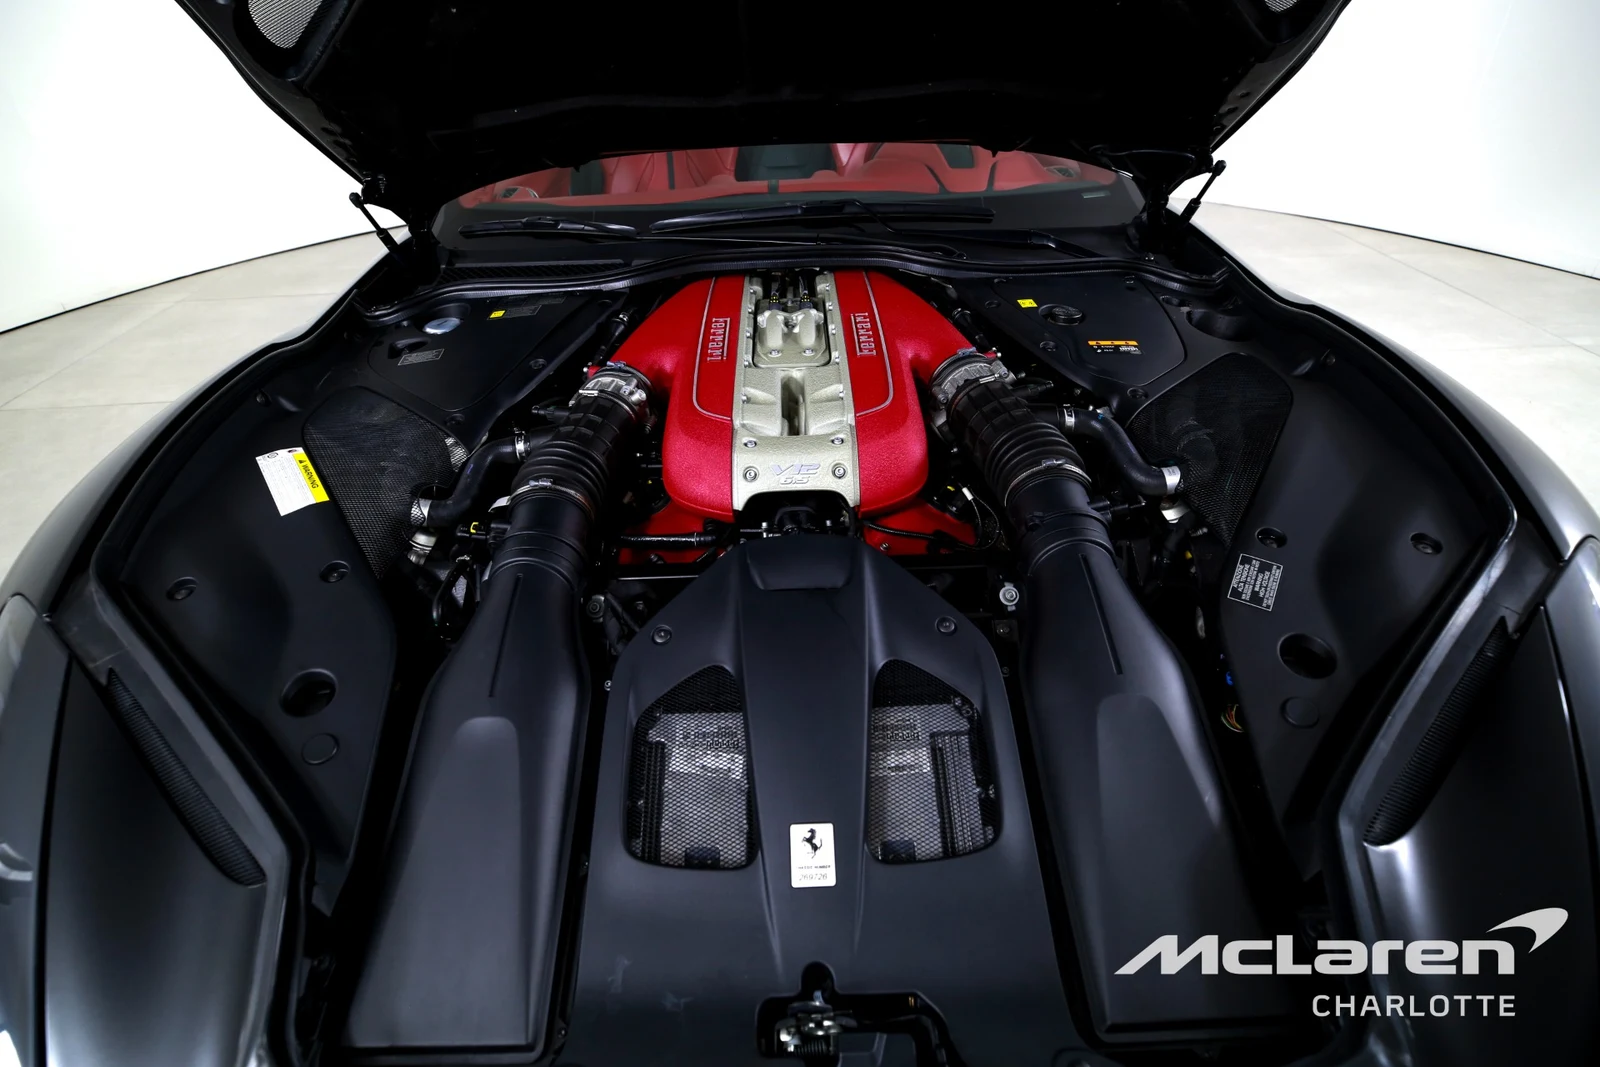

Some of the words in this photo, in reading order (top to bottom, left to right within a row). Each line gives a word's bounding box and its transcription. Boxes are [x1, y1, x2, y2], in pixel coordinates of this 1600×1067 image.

[707, 317, 731, 363] Ferrari
[850, 312, 877, 356] Ferrari
[302, 464, 319, 488] WARNING
[771, 463, 821, 476] V12
